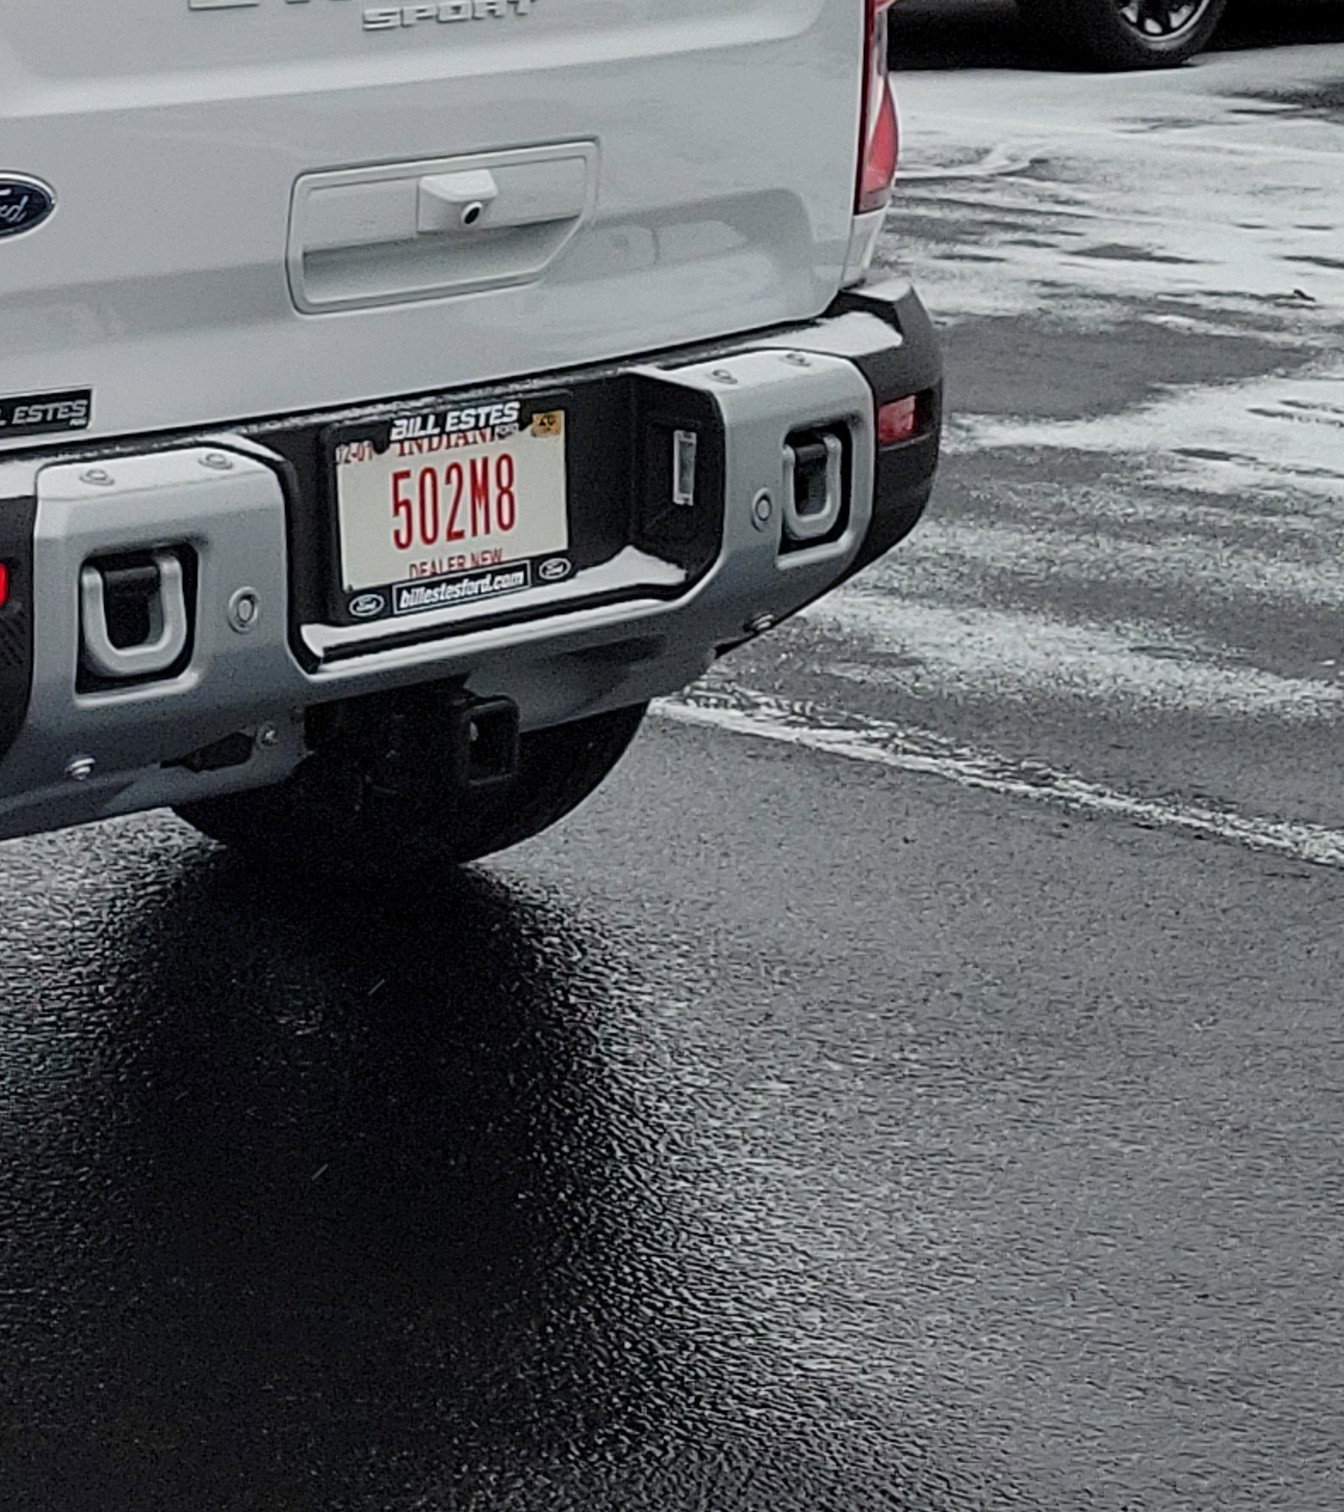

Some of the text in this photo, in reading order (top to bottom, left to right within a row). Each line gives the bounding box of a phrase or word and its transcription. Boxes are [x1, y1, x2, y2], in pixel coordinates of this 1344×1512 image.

[12, 399, 89, 425] ESTES
[390, 414, 441, 441] BILL
[445, 401, 521, 432] ESTES
[397, 427, 496, 457] INDIAN
[392, 453, 516, 551] 502M8
[399, 572, 525, 609] billestesford.com
